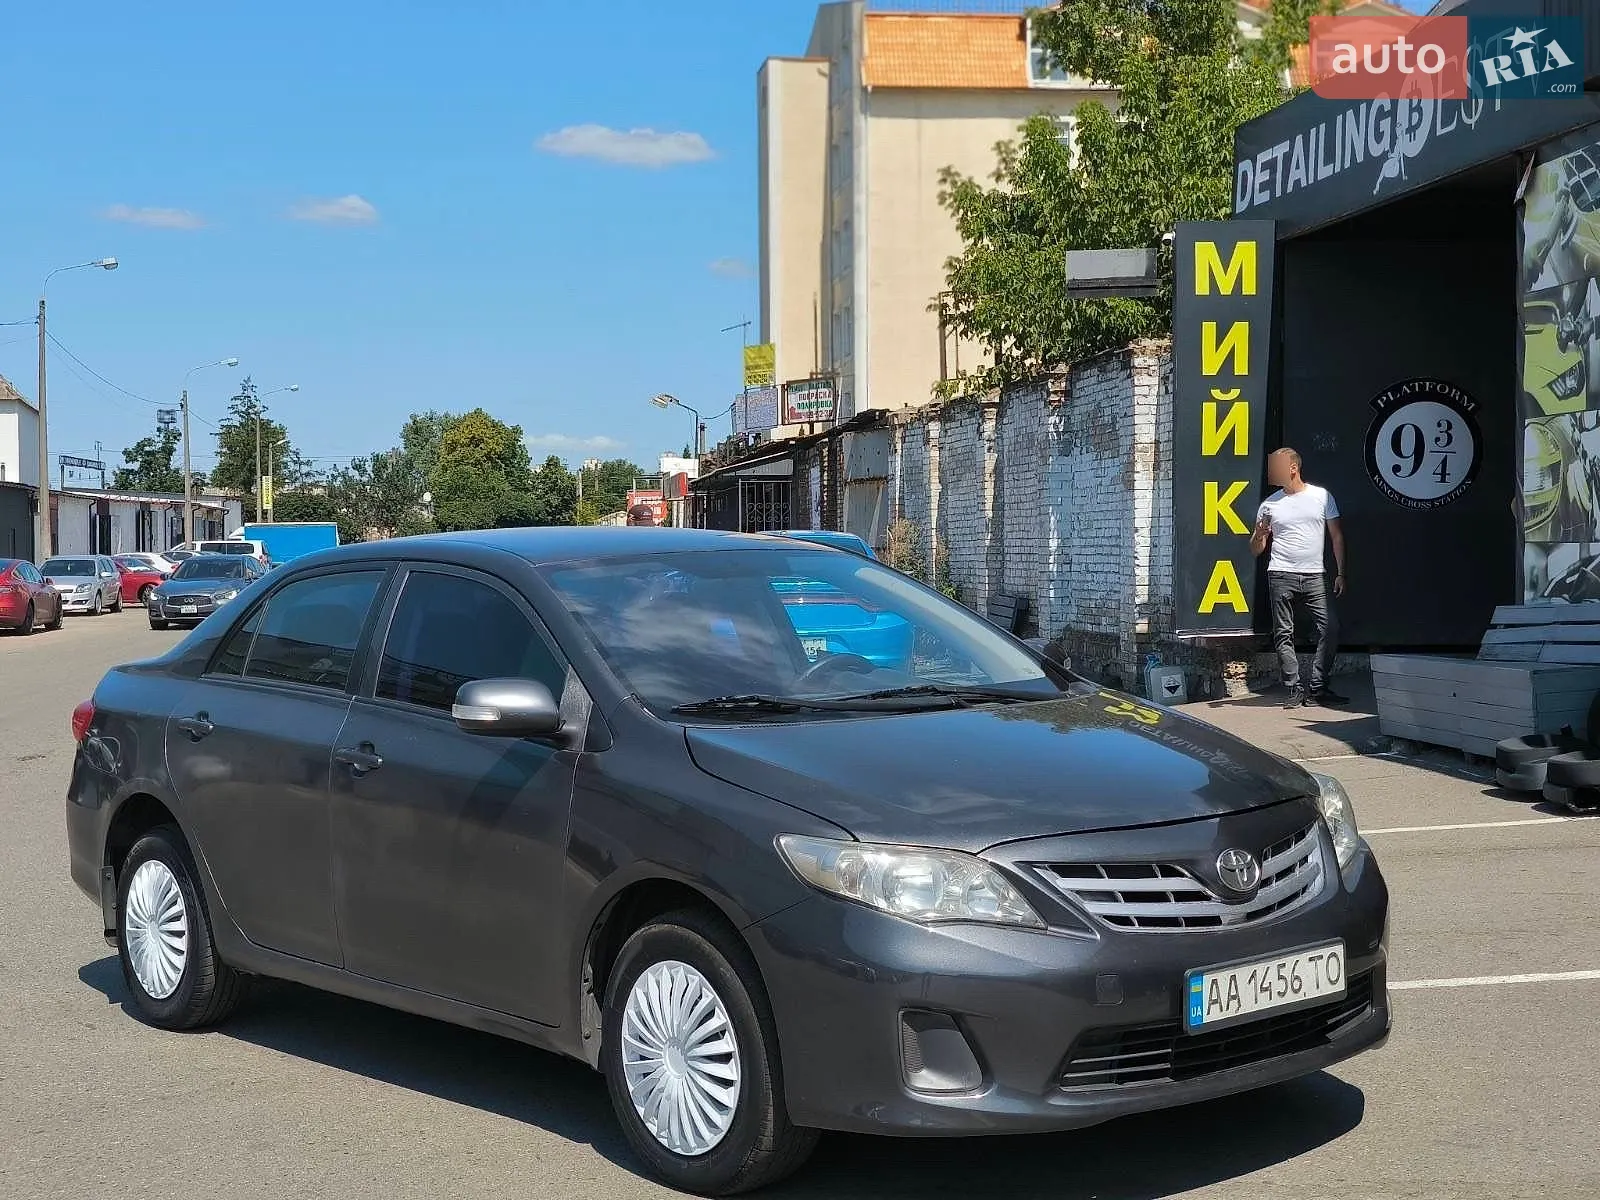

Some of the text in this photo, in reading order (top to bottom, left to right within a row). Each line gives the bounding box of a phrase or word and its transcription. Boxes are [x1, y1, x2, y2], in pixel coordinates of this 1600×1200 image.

[1235, 93, 1391, 214] DETAILING
[1377, 381, 1476, 411] PLATFORM
[1194, 241, 1257, 613] МИЙКА
[1374, 474, 1472, 509] KINGS CROSS STATION
[1247, 959, 1303, 1005] 1456
[1191, 1007, 1203, 1018] UA
